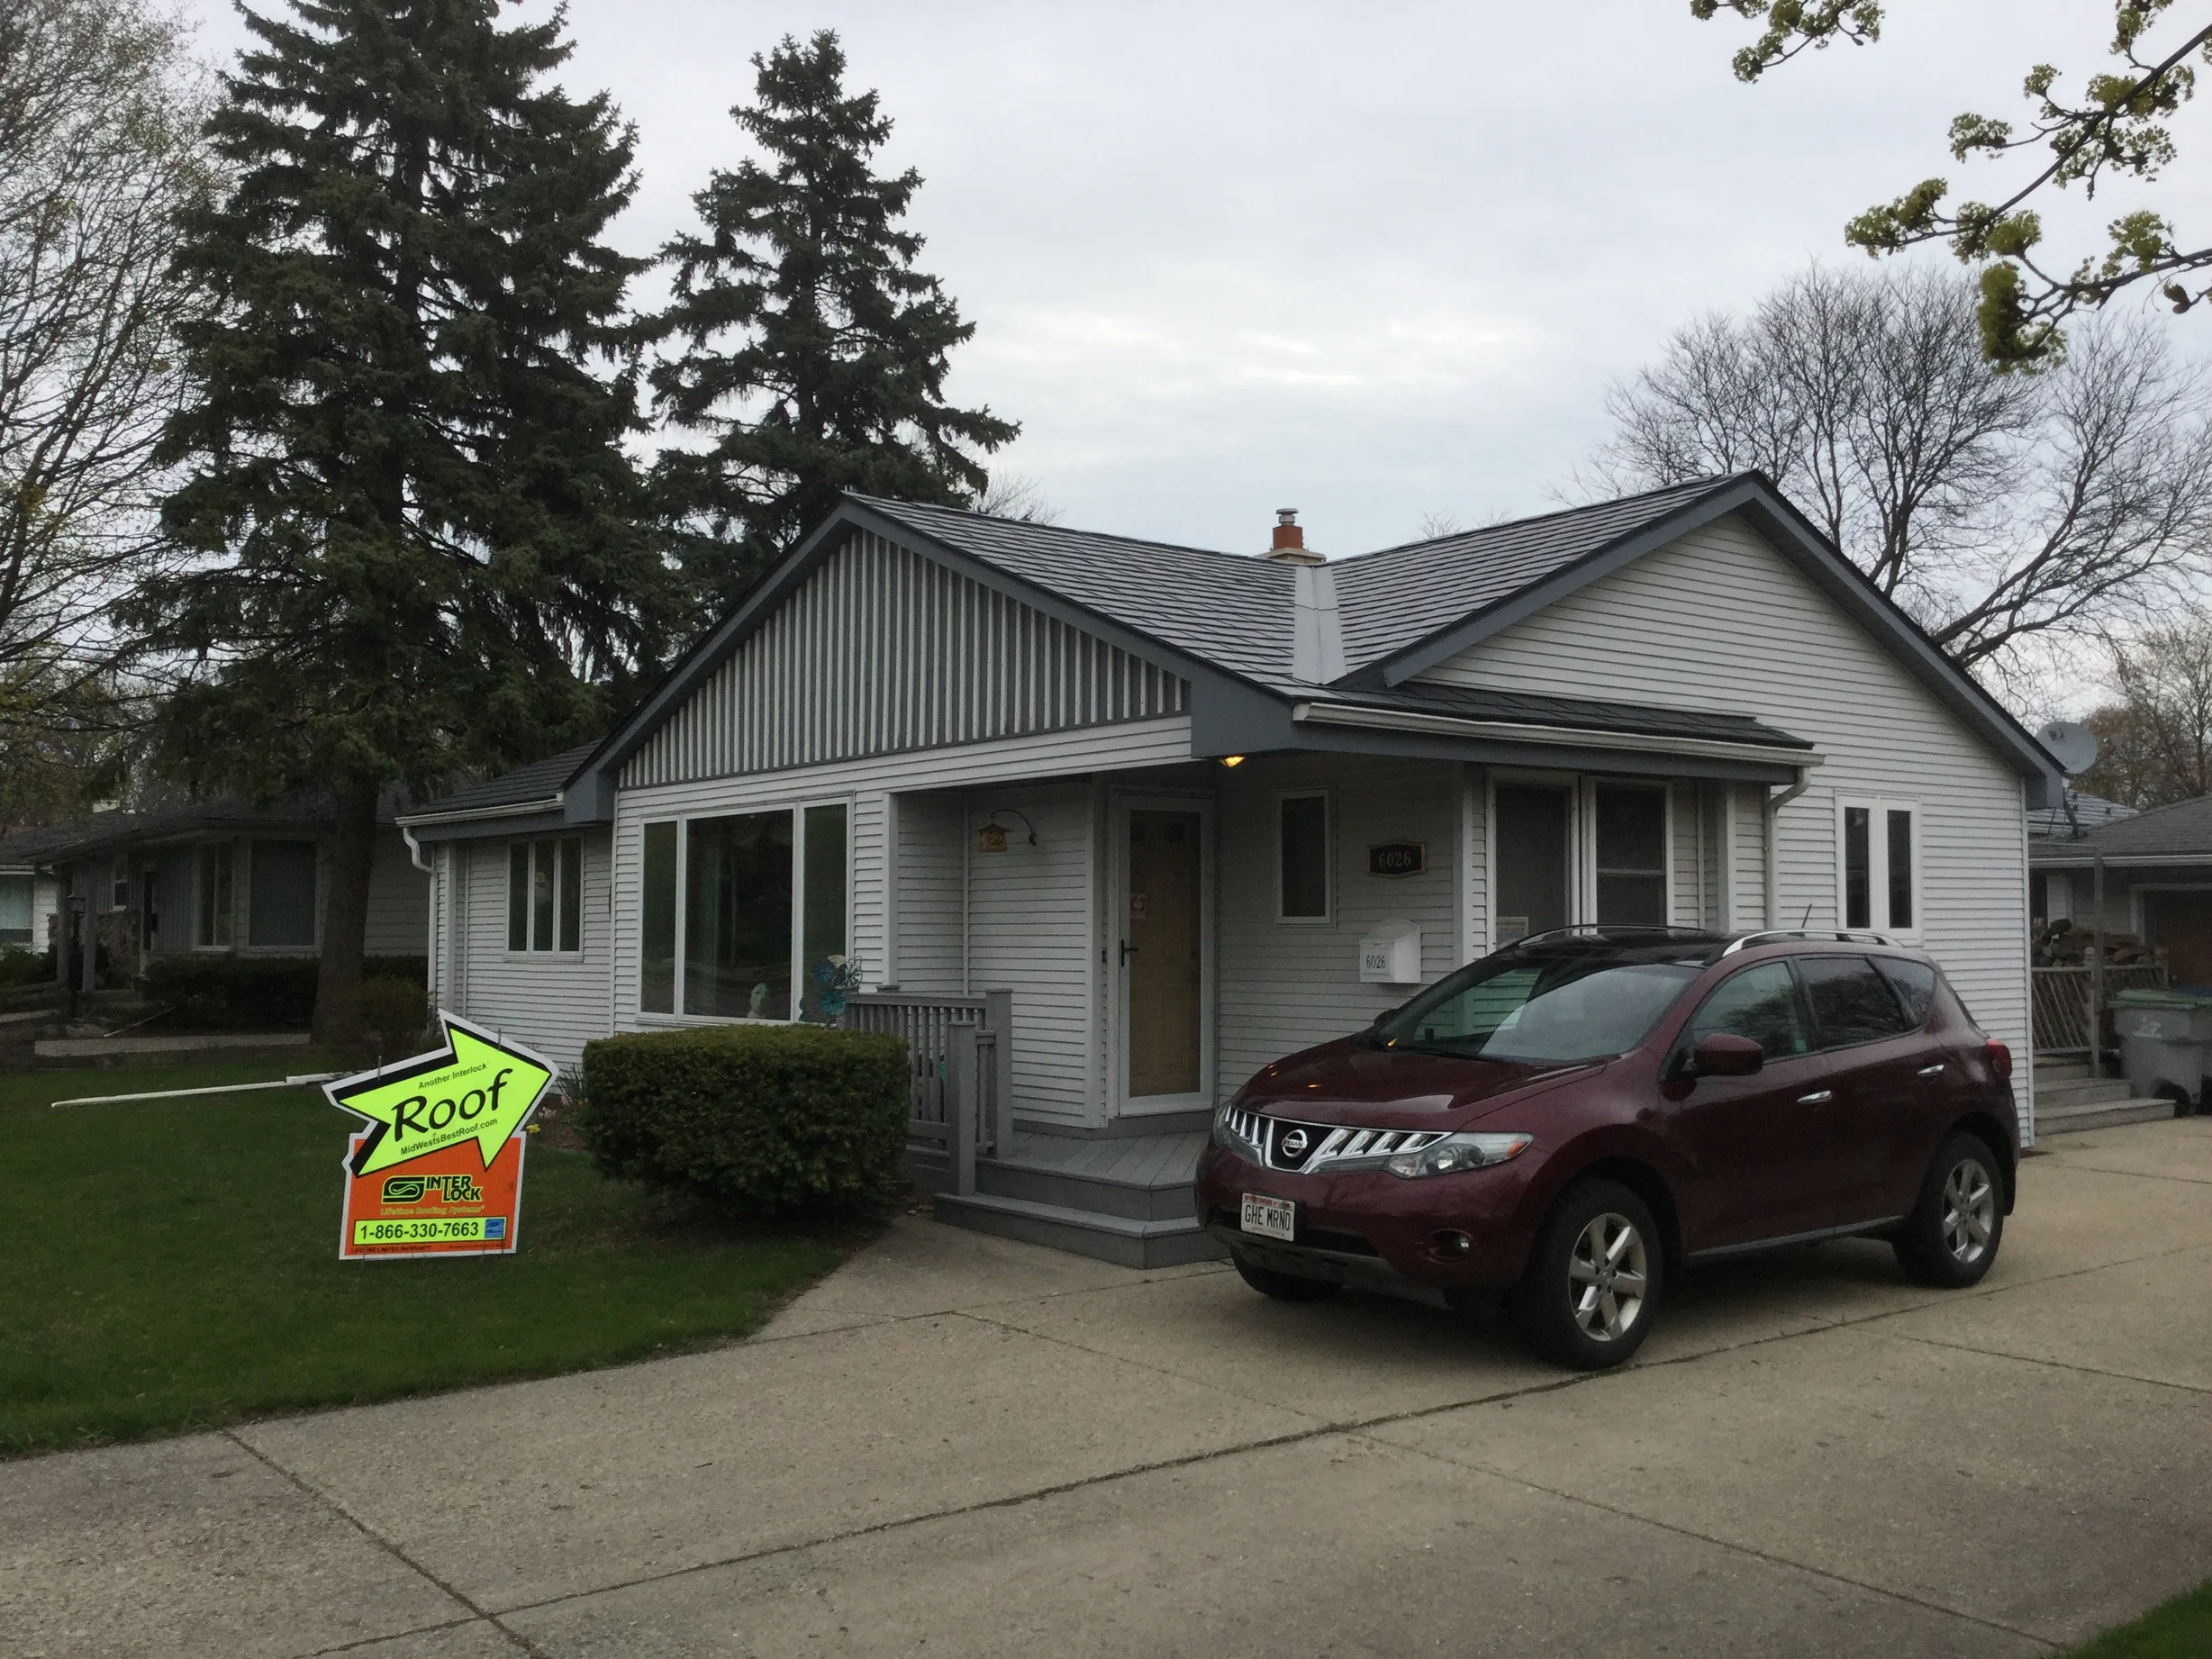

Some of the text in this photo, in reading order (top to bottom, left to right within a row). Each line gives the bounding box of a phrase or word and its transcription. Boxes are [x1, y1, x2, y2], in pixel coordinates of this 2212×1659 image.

[1378, 851, 1412, 867] 6026
[1365, 955, 1386, 969] 6026
[418, 1062, 487, 1090] Another Interlock
[391, 1068, 513, 1143] Roof
[400, 1118, 498, 1156] MidWestsBestRoof.com
[426, 1175, 472, 1190] INTER
[442, 1185, 482, 1201] LOCK
[1245, 1204, 1265, 1226] GHE
[360, 1222, 479, 1240] 1-866-330-7663
